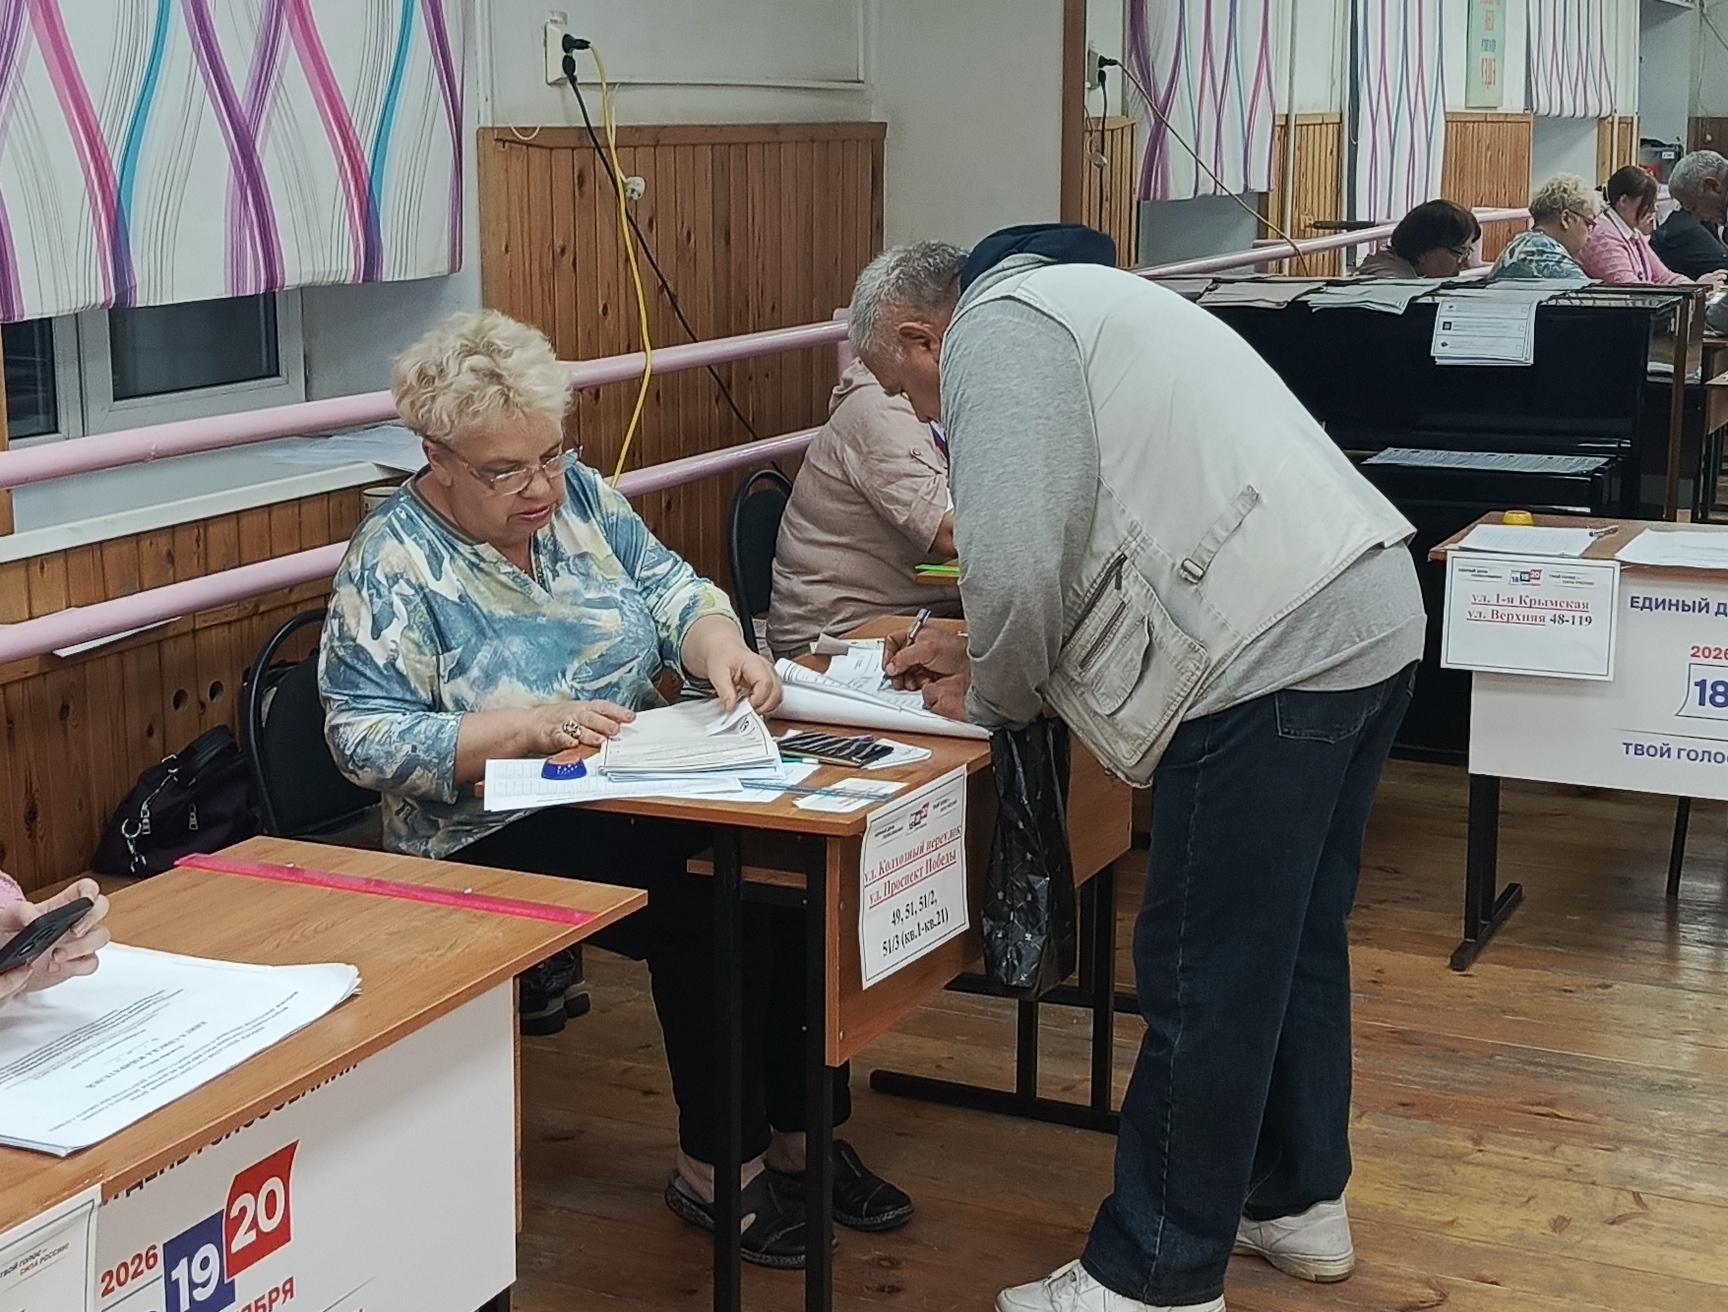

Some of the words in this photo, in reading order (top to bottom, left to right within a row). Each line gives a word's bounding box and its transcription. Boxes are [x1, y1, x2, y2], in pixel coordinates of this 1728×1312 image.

[1471, 593, 1490, 604] ул.
[1496, 593, 1514, 605] 1-я
[1518, 594, 1589, 611] Крымская
[1629, 595, 1710, 614] ЕДИНЫЙ
[1467, 609, 1486, 620] ул.
[1490, 609, 1546, 624] Верхняя
[1549, 613, 1593, 627] 48-119
[1693, 678, 1728, 708] 18
[1622, 742, 1672, 759] ТВОЙ
[1677, 748, 1728, 765] ГОЛО
[878, 840, 925, 876] Колхозный
[883, 866, 924, 897] Проспект
[925, 849, 957, 876] Победы
[891, 908, 904, 926] 49,
[905, 901, 918, 919] 51,
[919, 889, 938, 912] 51/2,
[882, 934, 900, 957] 51/3
[229, 1176, 286, 1254] 20
[100, 1244, 159, 1299] 2026
